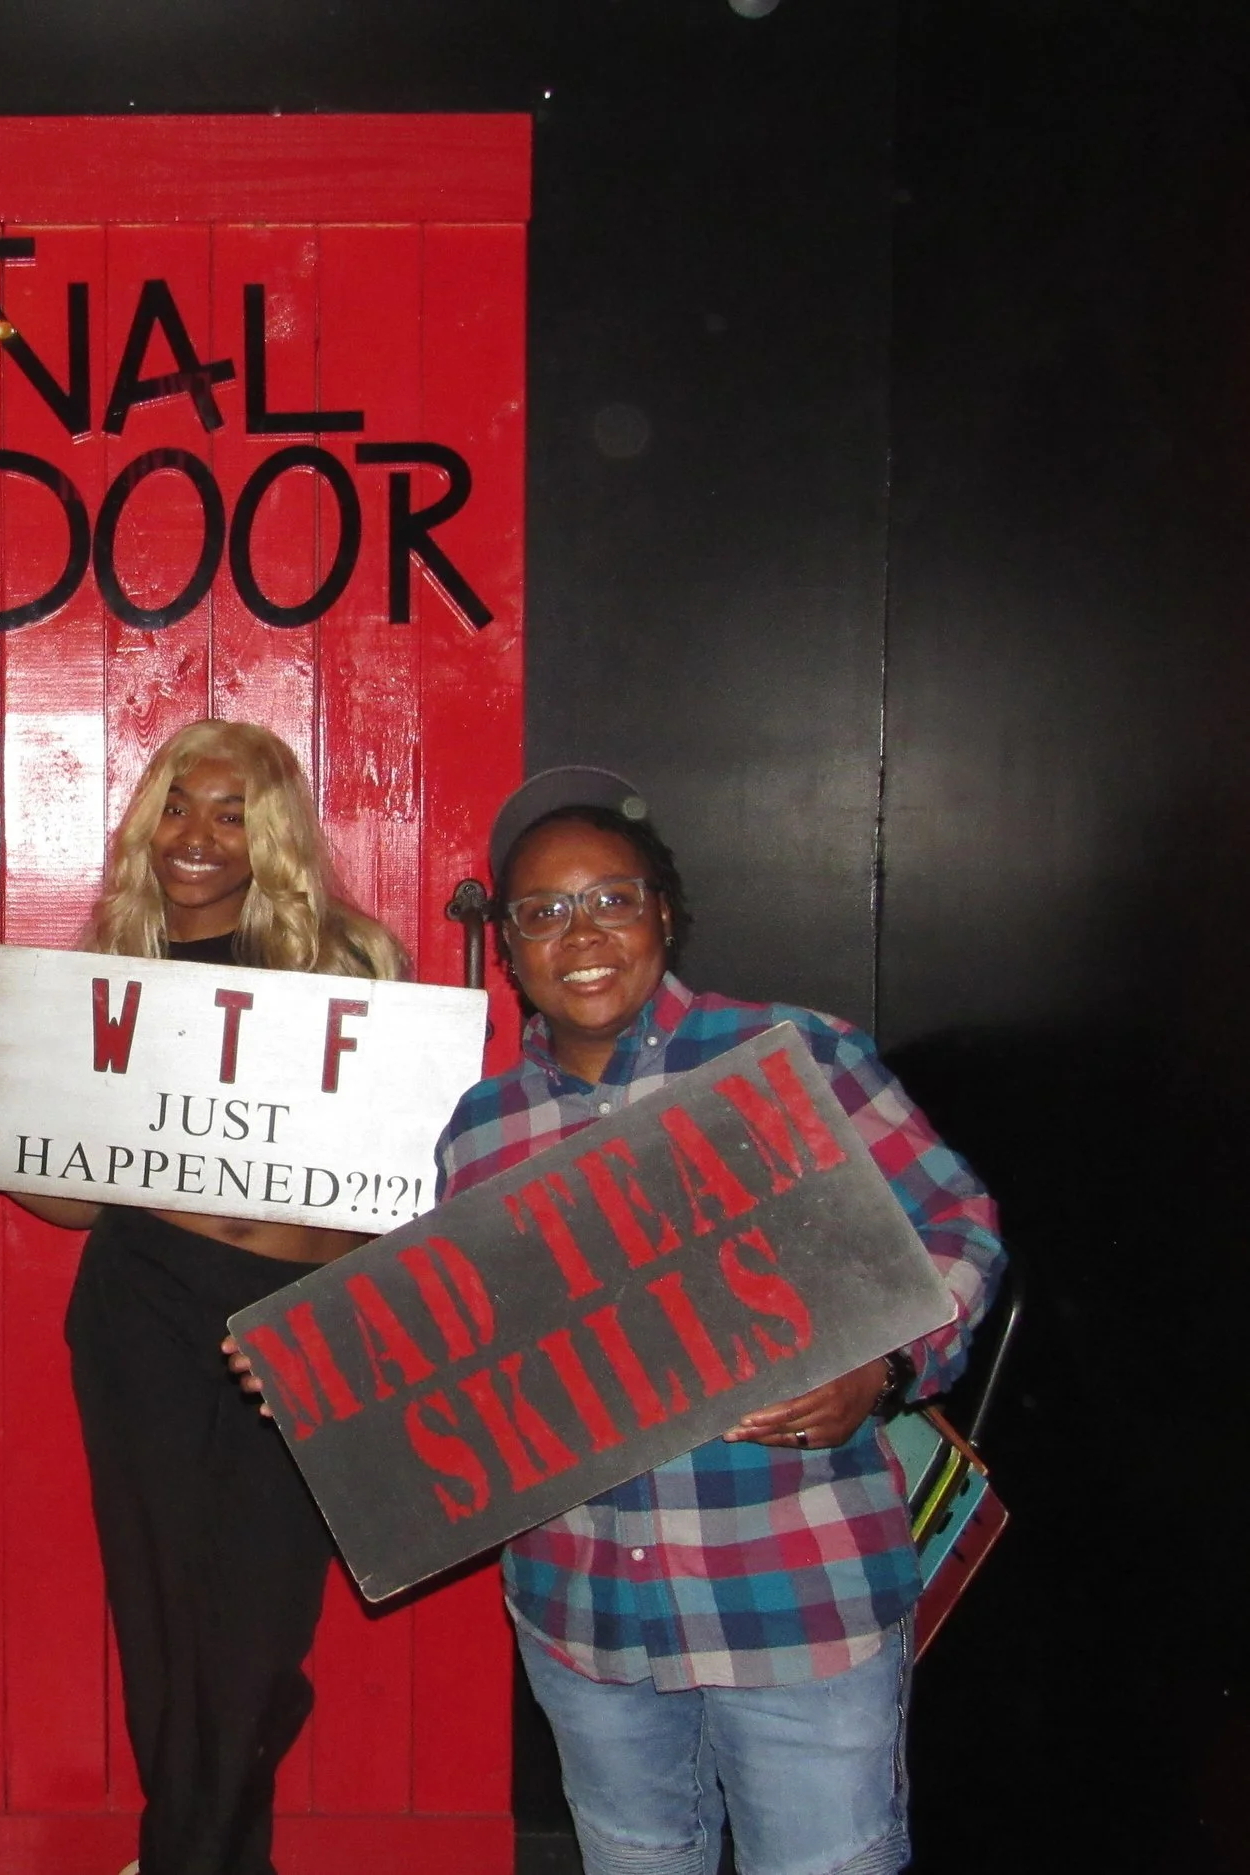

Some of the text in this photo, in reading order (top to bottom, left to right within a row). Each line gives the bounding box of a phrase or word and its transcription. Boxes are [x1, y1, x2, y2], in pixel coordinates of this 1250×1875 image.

[15, 1135, 422, 1219] HAPPENED?!?!
[149, 1093, 290, 1144] JUST
[244, 1048, 846, 1441] MAD TEAM
[404, 1227, 812, 1524] SKILLS
